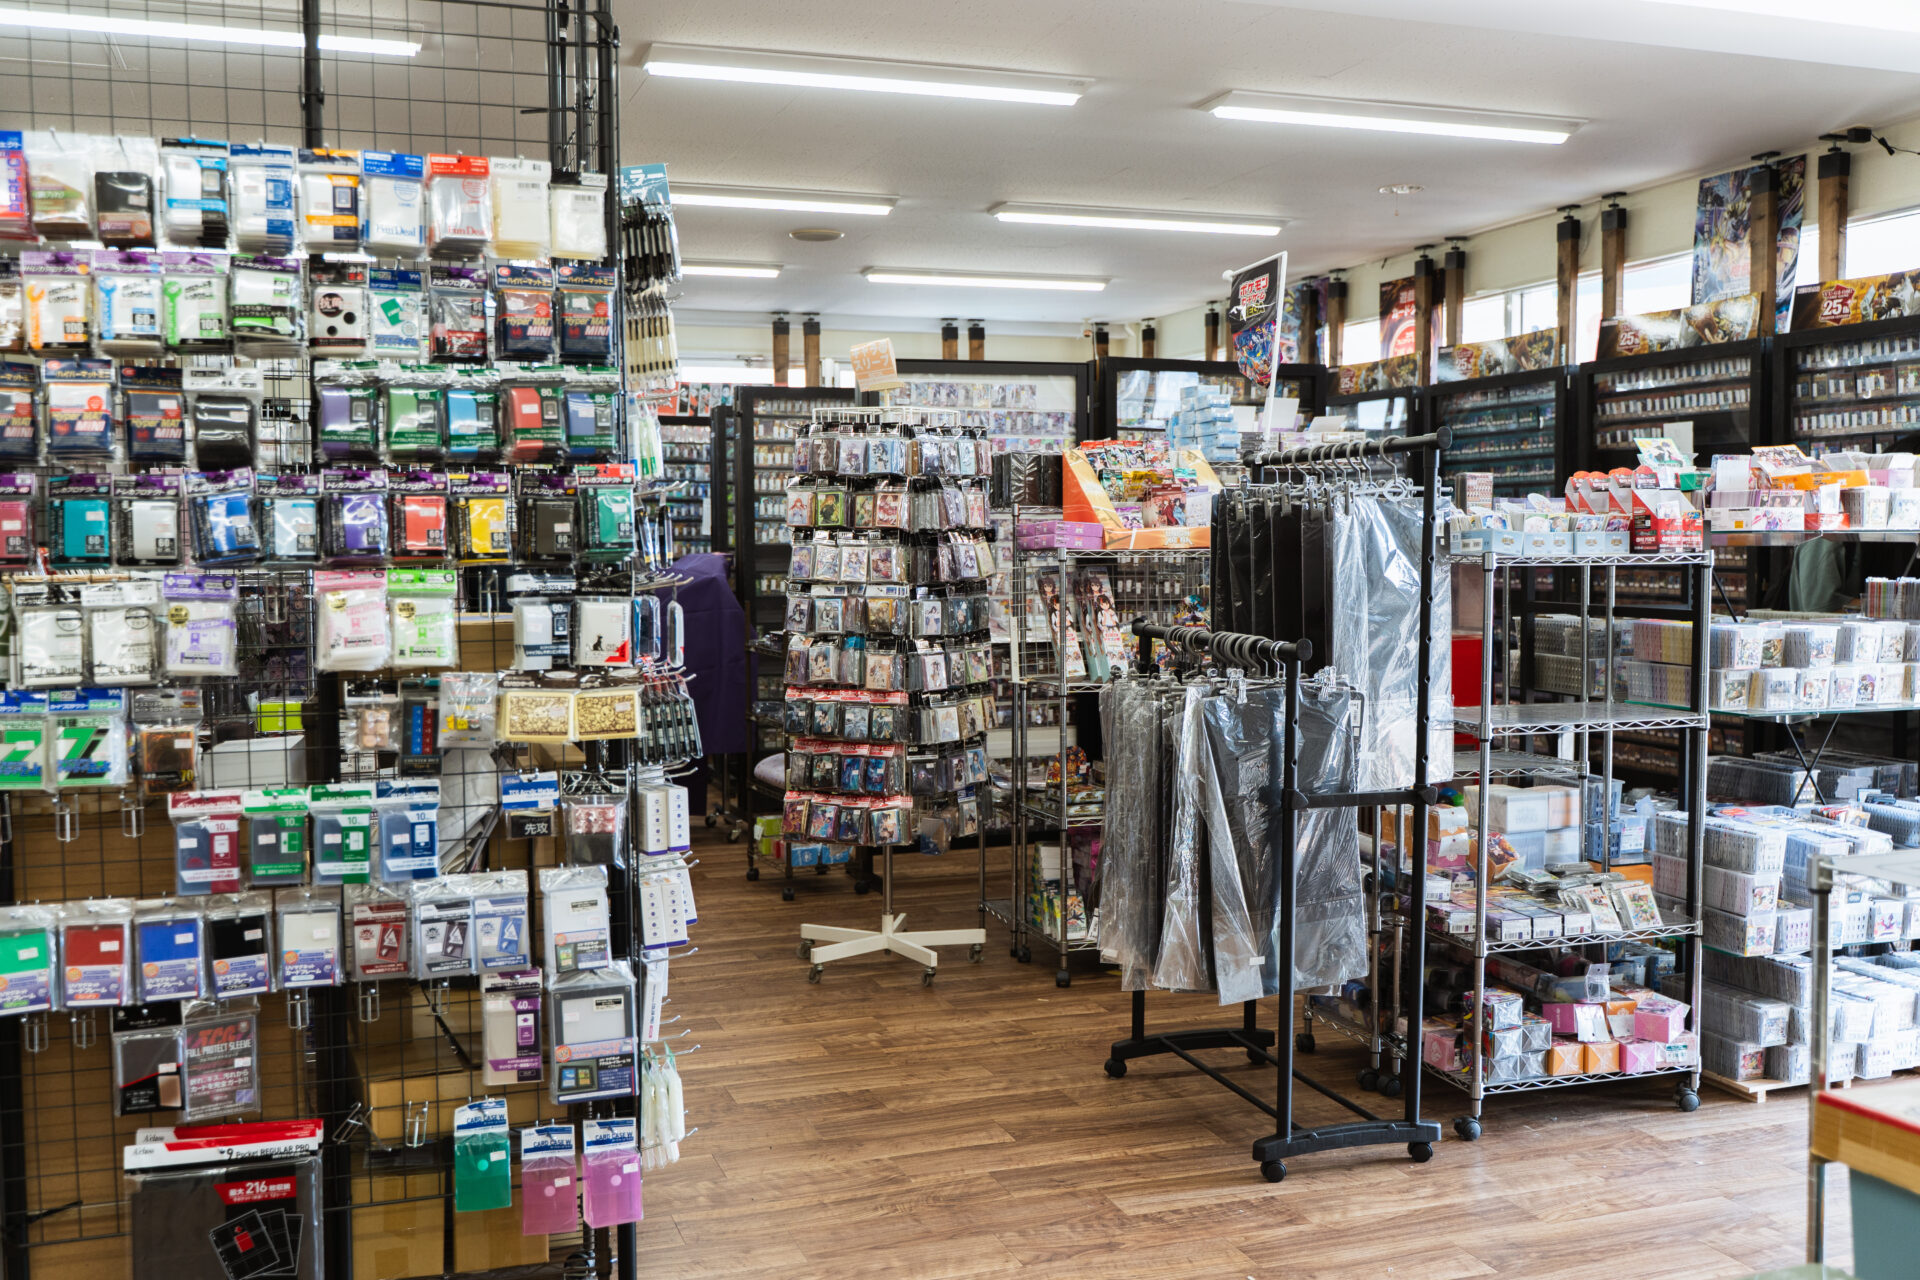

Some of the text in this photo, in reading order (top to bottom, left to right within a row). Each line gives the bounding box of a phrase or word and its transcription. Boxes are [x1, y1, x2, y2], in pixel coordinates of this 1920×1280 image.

[1239, 274, 1269, 298] ポケモン
[1241, 302, 1265, 320] EGA
[526, 326, 553, 337] MINI
[584, 325, 610, 336] MINI
[541, 388, 552, 397] 80
[594, 395, 606, 403] 80
[3, 426, 34, 437] MINI
[75, 420, 106, 432] MINI
[154, 427, 183, 438] MINI
[181, 770, 194, 781] 70
[538, 787, 556, 795] Marker
[284, 818, 295, 827] 10
[347, 817, 358, 825] 10
[416, 813, 426, 821] 10
[215, 823, 226, 832] 10
[524, 823, 549, 836] 先攻
[517, 1000, 529, 1010] 40
[199, 1025, 238, 1046] TCG
[187, 1039, 252, 1058] FULL PROTECT SLEEVE
[483, 1113, 498, 1121] CASE
[226, 1143, 311, 1160] 9 Pocket REGULAR PRO
